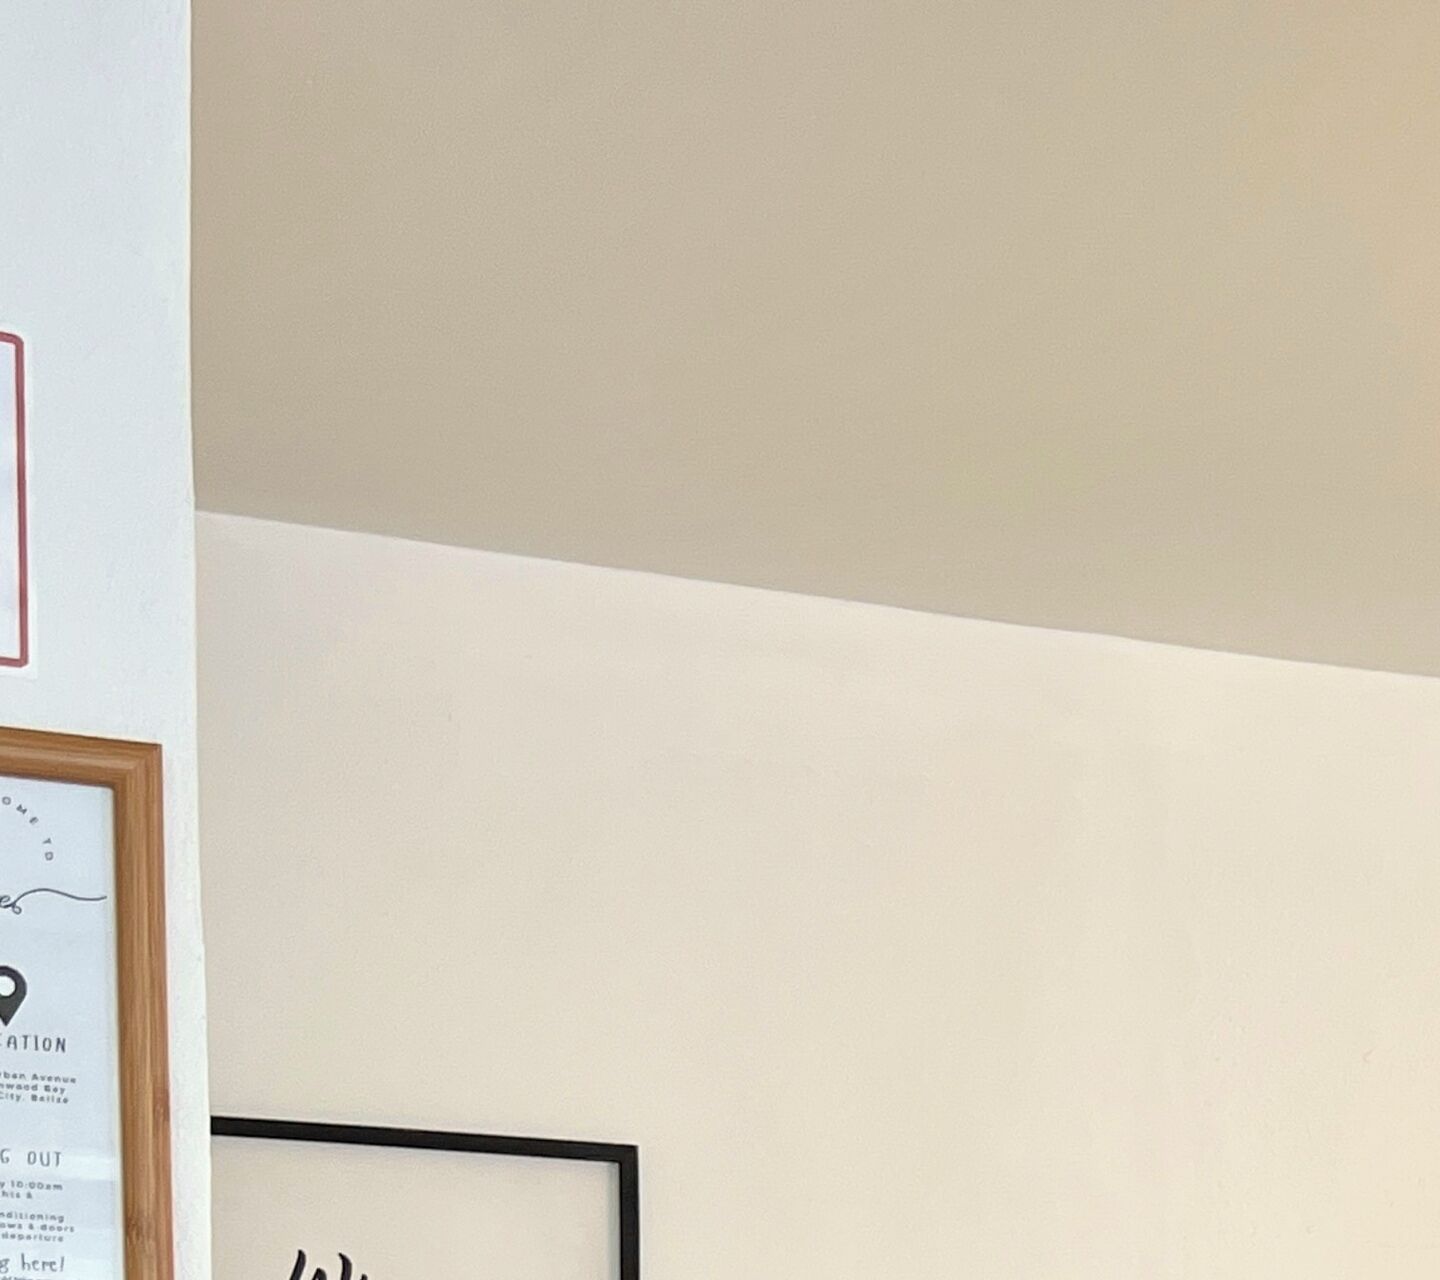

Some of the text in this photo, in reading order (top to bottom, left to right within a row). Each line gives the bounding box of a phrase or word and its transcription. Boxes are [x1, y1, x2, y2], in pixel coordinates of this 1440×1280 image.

[0, 1033, 67, 1053] ATION
[32, 1073, 76, 1083] Avenue
[31, 1094, 69, 1104] Belize
[27, 1150, 62, 1167] OUT
[40, 1224, 75, 1233] doors
[20, 1252, 65, 1272] here!
